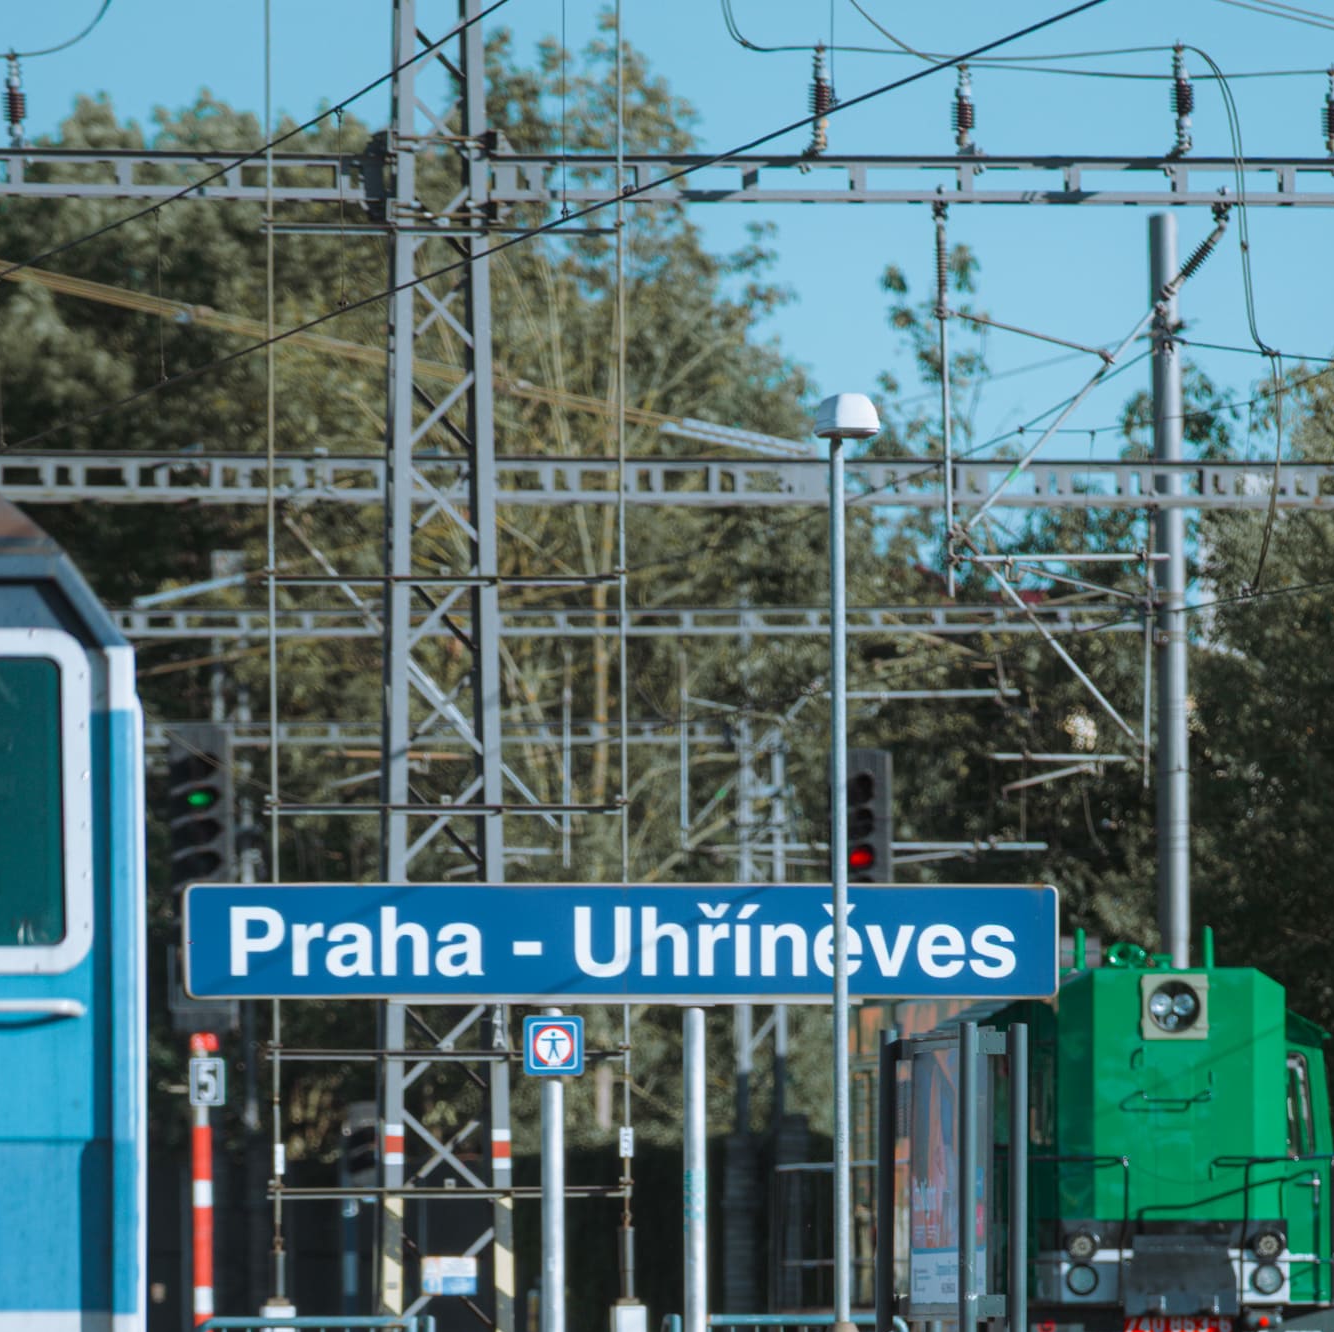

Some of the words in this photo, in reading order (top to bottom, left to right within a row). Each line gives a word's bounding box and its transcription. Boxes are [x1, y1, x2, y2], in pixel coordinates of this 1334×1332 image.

[230, 906, 484, 977] Praha
[513, 941, 542, 956] -
[574, 903, 1016, 979] Uhříněves
[197, 1063, 217, 1102] 5
